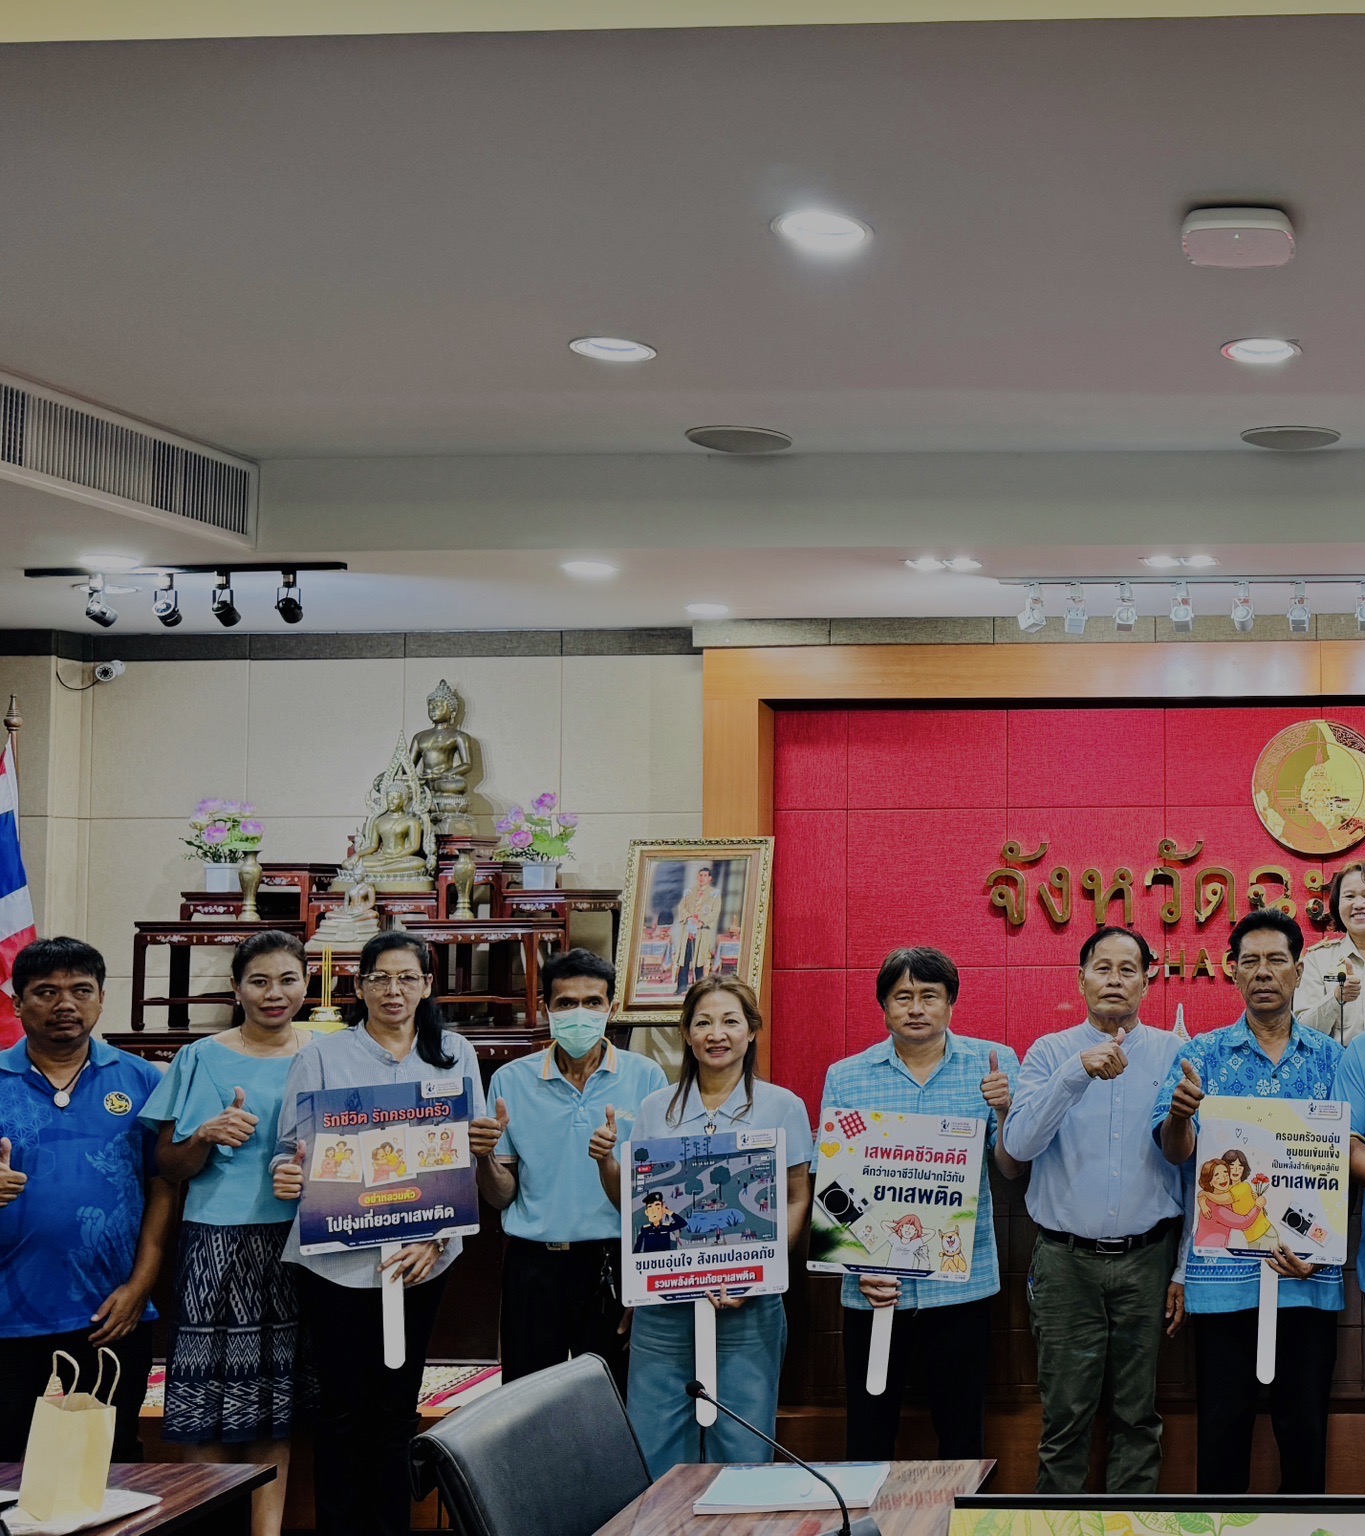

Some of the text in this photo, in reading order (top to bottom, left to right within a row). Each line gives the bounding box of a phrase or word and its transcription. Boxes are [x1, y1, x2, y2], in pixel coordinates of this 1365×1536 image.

[323, 1102, 451, 1128] รักชีวิต รักครอบครัว
[864, 1144, 968, 1165] เสพติดชีวิตดีดี
[1286, 1144, 1340, 1160] ชุมชนเข้มแข็ง
[1271, 1173, 1339, 1191] ยาเสพติด
[873, 1184, 963, 1207] ยาเสพติด
[326, 1205, 455, 1236] ไปยุ่งเกี่ยวยาเสพติด
[635, 1246, 775, 1275] ชุมชนอุ่นใจ สังคมปลอดภัย
